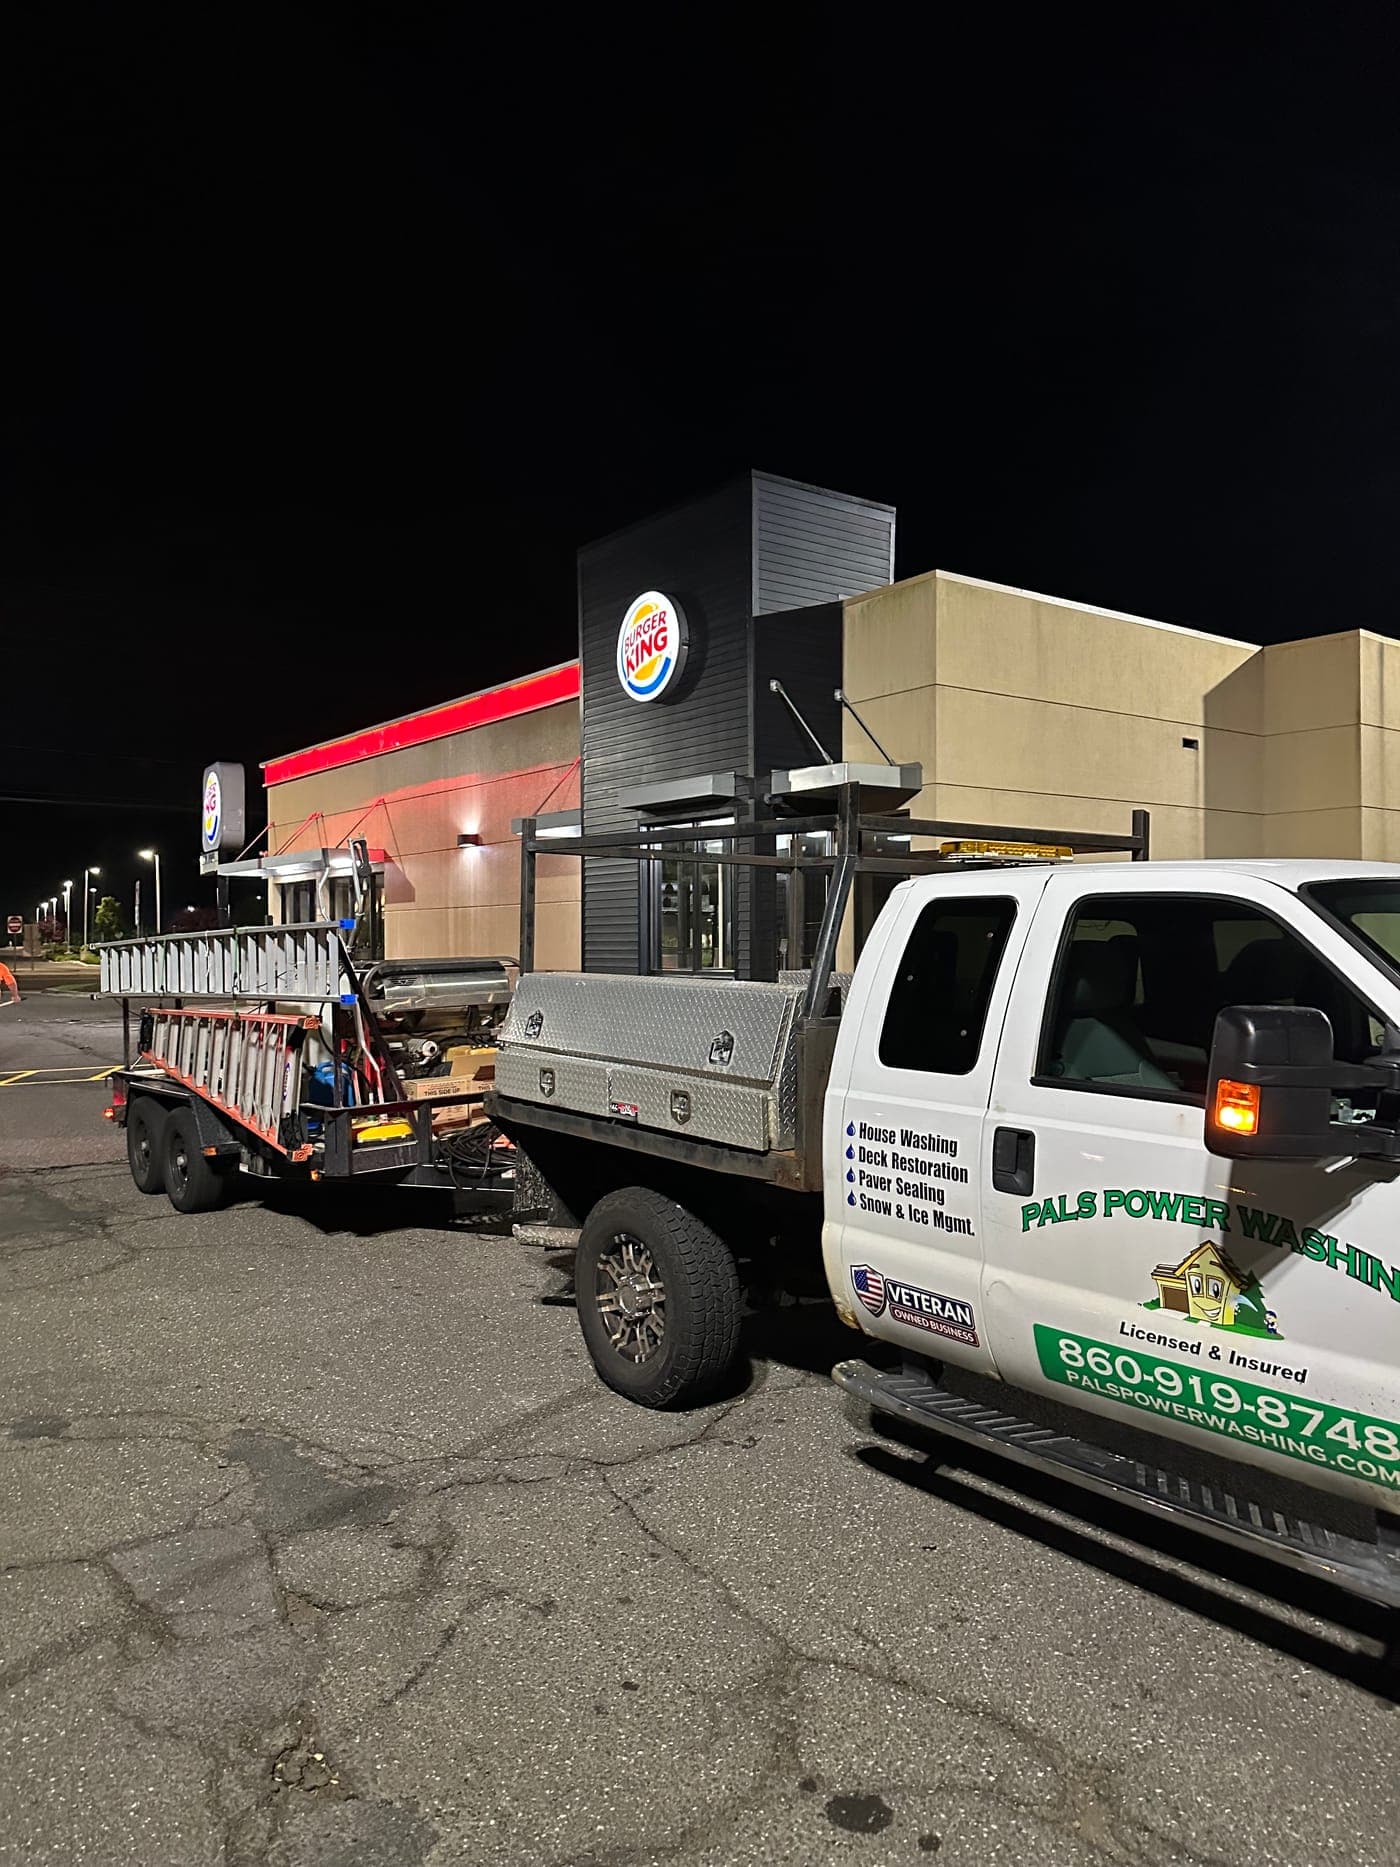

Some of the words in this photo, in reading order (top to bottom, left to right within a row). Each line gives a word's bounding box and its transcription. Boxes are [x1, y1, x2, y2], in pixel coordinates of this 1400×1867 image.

[625, 610, 667, 654] BURGER
[626, 626, 668, 678] KING
[859, 1122, 896, 1145] House
[900, 1129, 958, 1158] Washing
[858, 1146, 888, 1168] Deck
[892, 1153, 969, 1184] Restoration
[859, 1169, 892, 1193] Paver
[896, 1178, 946, 1206] Sealing
[859, 1193, 892, 1217] Snow
[895, 1203, 905, 1220] &
[908, 1205, 929, 1225] Ice
[934, 1210, 976, 1237] Mgmt.
[1020, 1191, 1098, 1232] PALS
[1103, 1189, 1231, 1232] POWER
[1237, 1205, 1400, 1303] WASHIN
[888, 1283, 972, 1326] VETERAN
[894, 1308, 930, 1329] OWNED
[930, 1318, 974, 1343] BUSINESS
[1119, 1320, 1202, 1357] Licensed
[1208, 1344, 1222, 1361] &
[1229, 1350, 1309, 1384] Insured
[1057, 1338, 1400, 1462] 860-919-8748
[1065, 1370, 1400, 1487] PALSPOWERWASHING.COM
